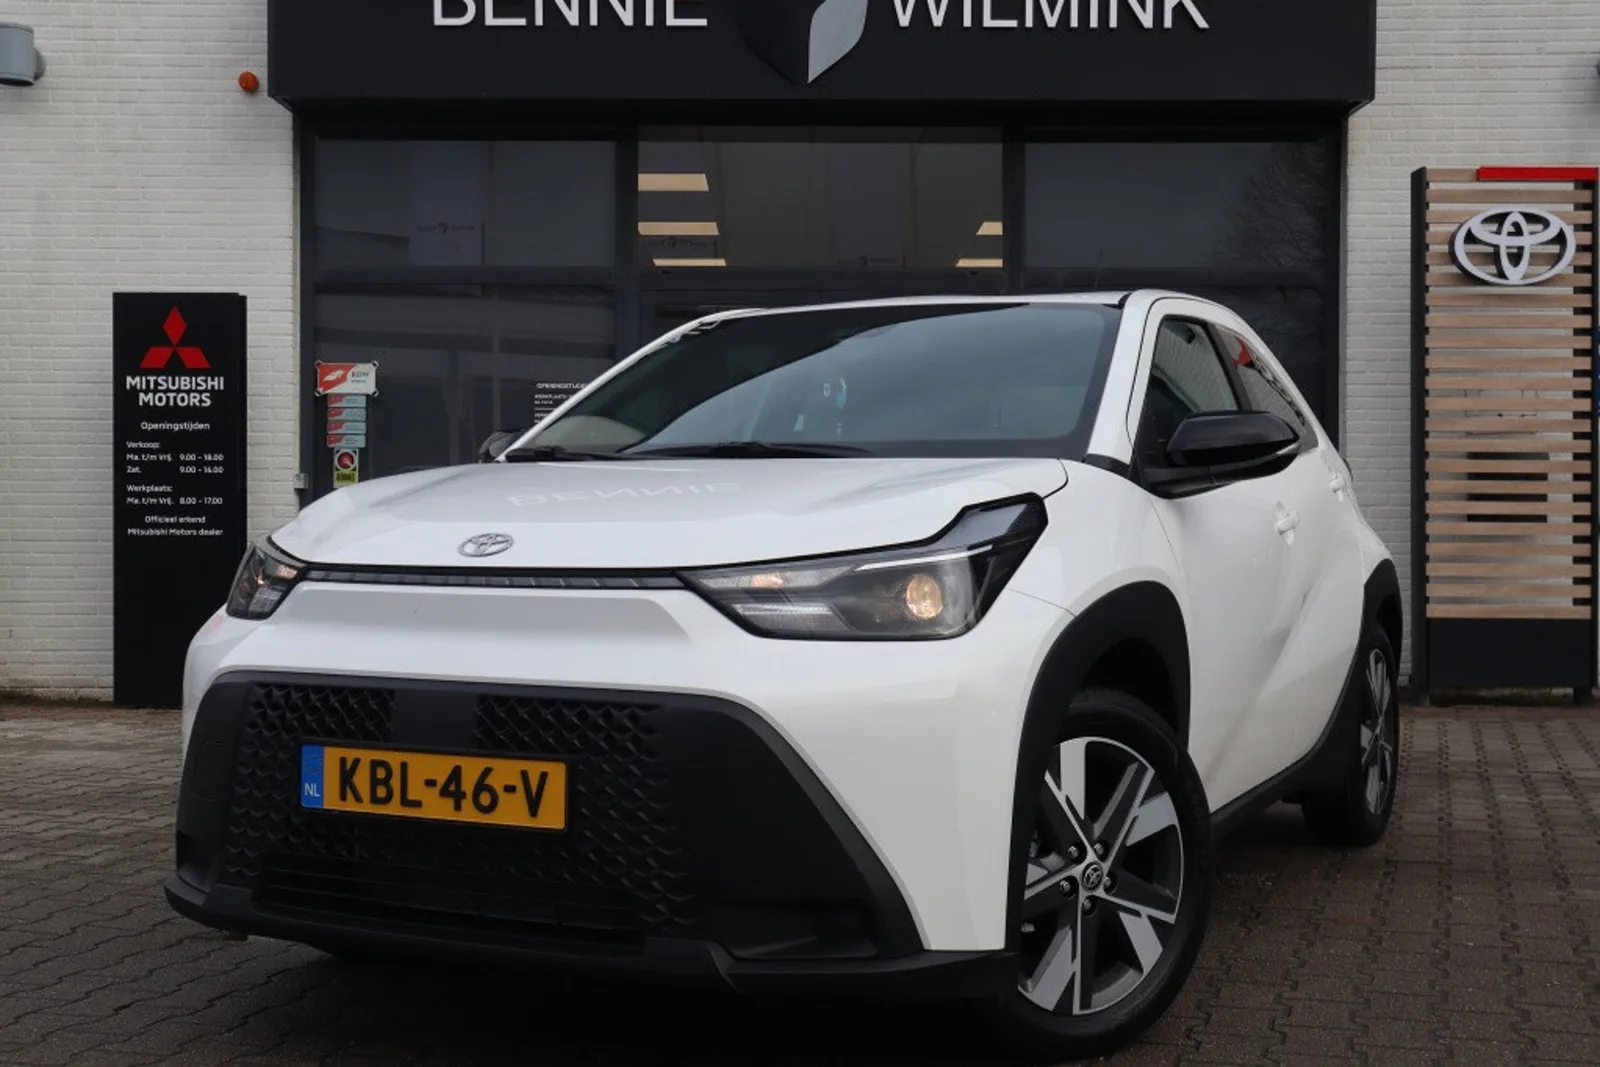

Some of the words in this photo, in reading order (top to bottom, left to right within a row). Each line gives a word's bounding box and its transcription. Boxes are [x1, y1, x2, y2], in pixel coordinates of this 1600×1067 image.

[125, 376, 225, 391] MITSUBISHI
[138, 392, 212, 407] MOTORS
[140, 421, 211, 431] Openingstijden
[126, 441, 160, 449] Verkoop:
[126, 453, 141, 461] Ma.
[141, 453, 157, 461] t/m
[179, 453, 196, 461] 9.00
[204, 453, 224, 461] 18.00
[126, 485, 173, 493] Werkplaats:
[127, 528, 167, 536] Mitsubishi
[168, 528, 197, 536] Motors
[198, 528, 223, 536] dealer
[304, 783, 321, 797] NL
[338, 756, 549, 818] KBL-46-V
